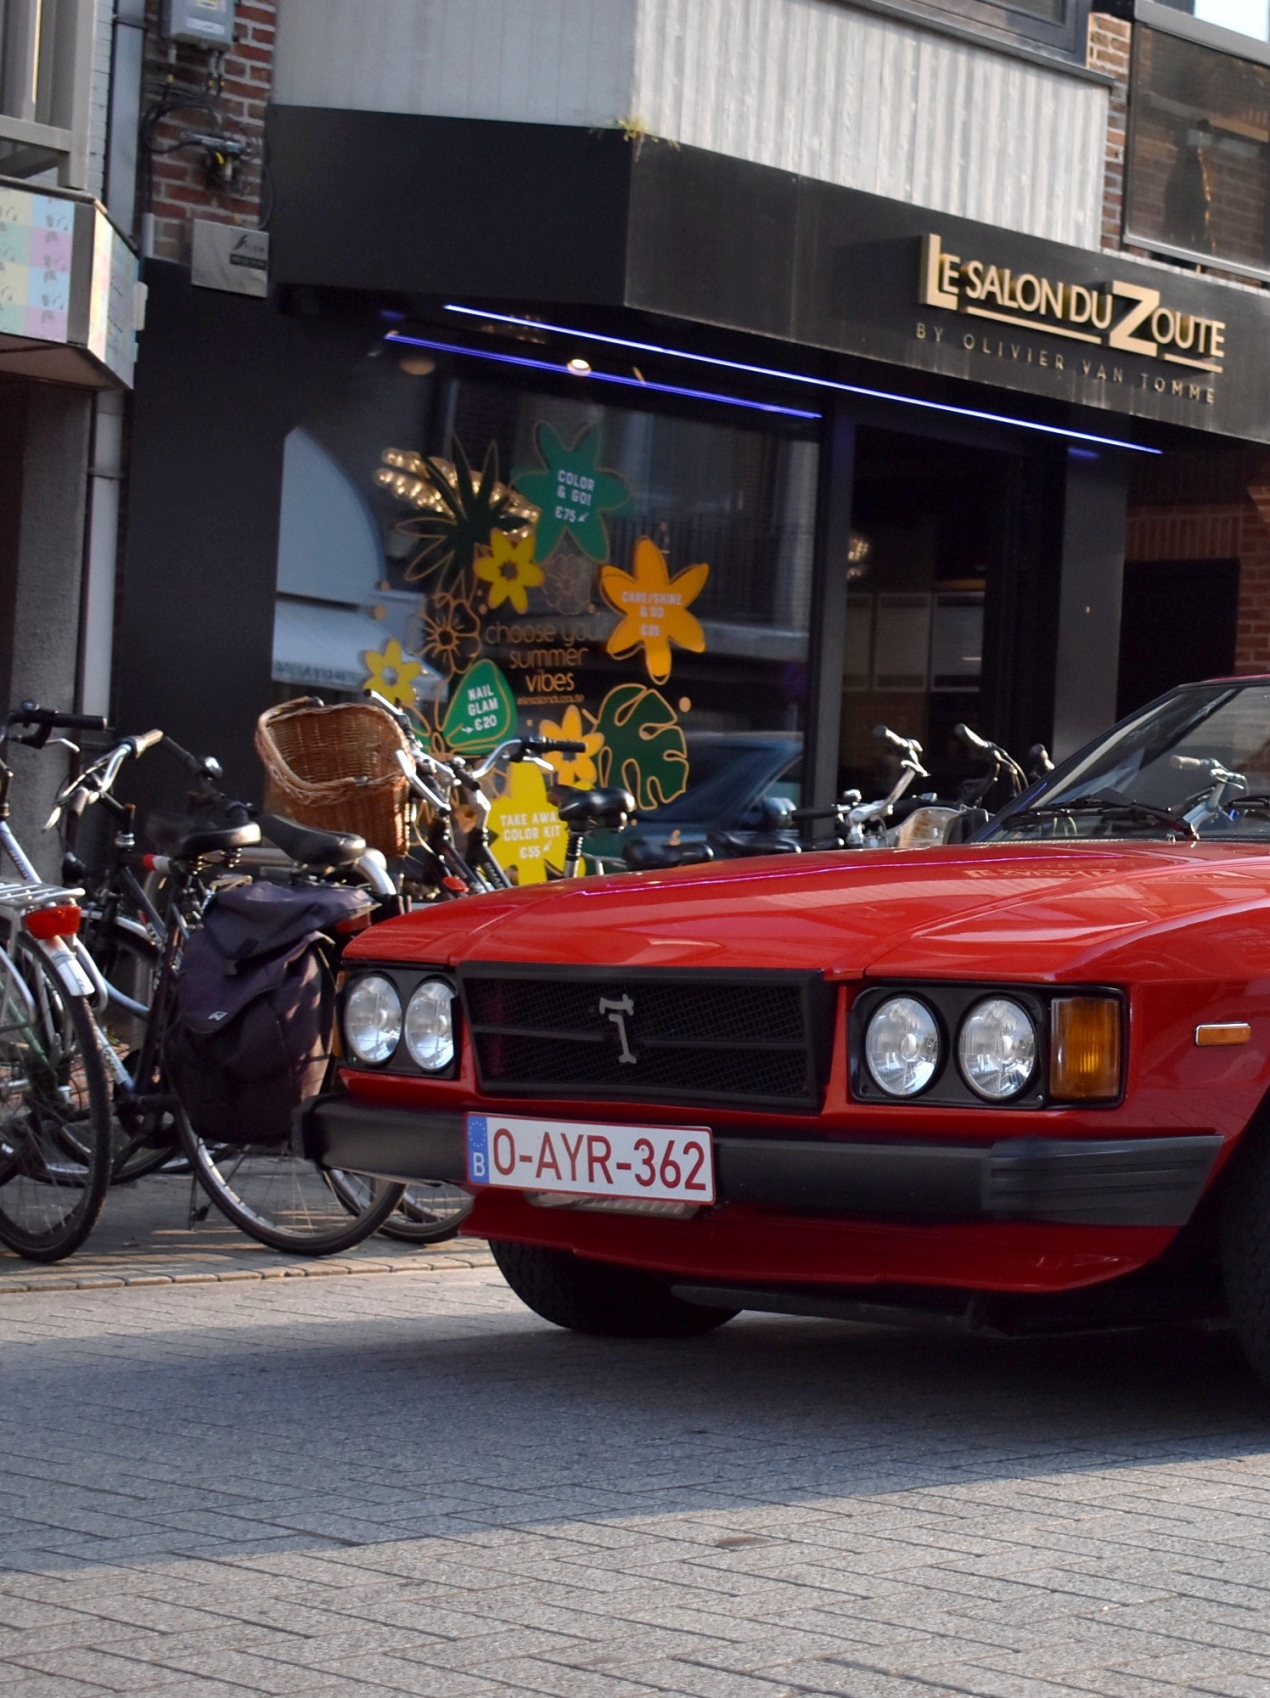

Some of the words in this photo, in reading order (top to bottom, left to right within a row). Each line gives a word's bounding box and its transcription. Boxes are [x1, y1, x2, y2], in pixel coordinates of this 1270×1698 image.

[923, 232, 961, 311] LE
[966, 260, 1064, 320] SALON
[1069, 284, 1113, 330] DU
[1109, 279, 1226, 358] ZOUTE
[916, 322, 943, 343] BY
[962, 333, 1065, 371] OLIVIER
[1082, 359, 1124, 383] VAN
[1141, 373, 1215, 404] TOMME
[557, 469, 595, 492] COLOR
[557, 484, 566, 499] &
[485, 620, 557, 645] choose
[509, 646, 590, 669] summer
[467, 683, 495, 701] NAIL
[524, 668, 576, 693] vibes
[467, 697, 499, 716] GLAM
[500, 812, 528, 827] TAKE
[532, 810, 560, 824] AWA
[503, 826, 539, 842] COLOR
[543, 825, 561, 838] KIT
[473, 1152, 486, 1177] B
